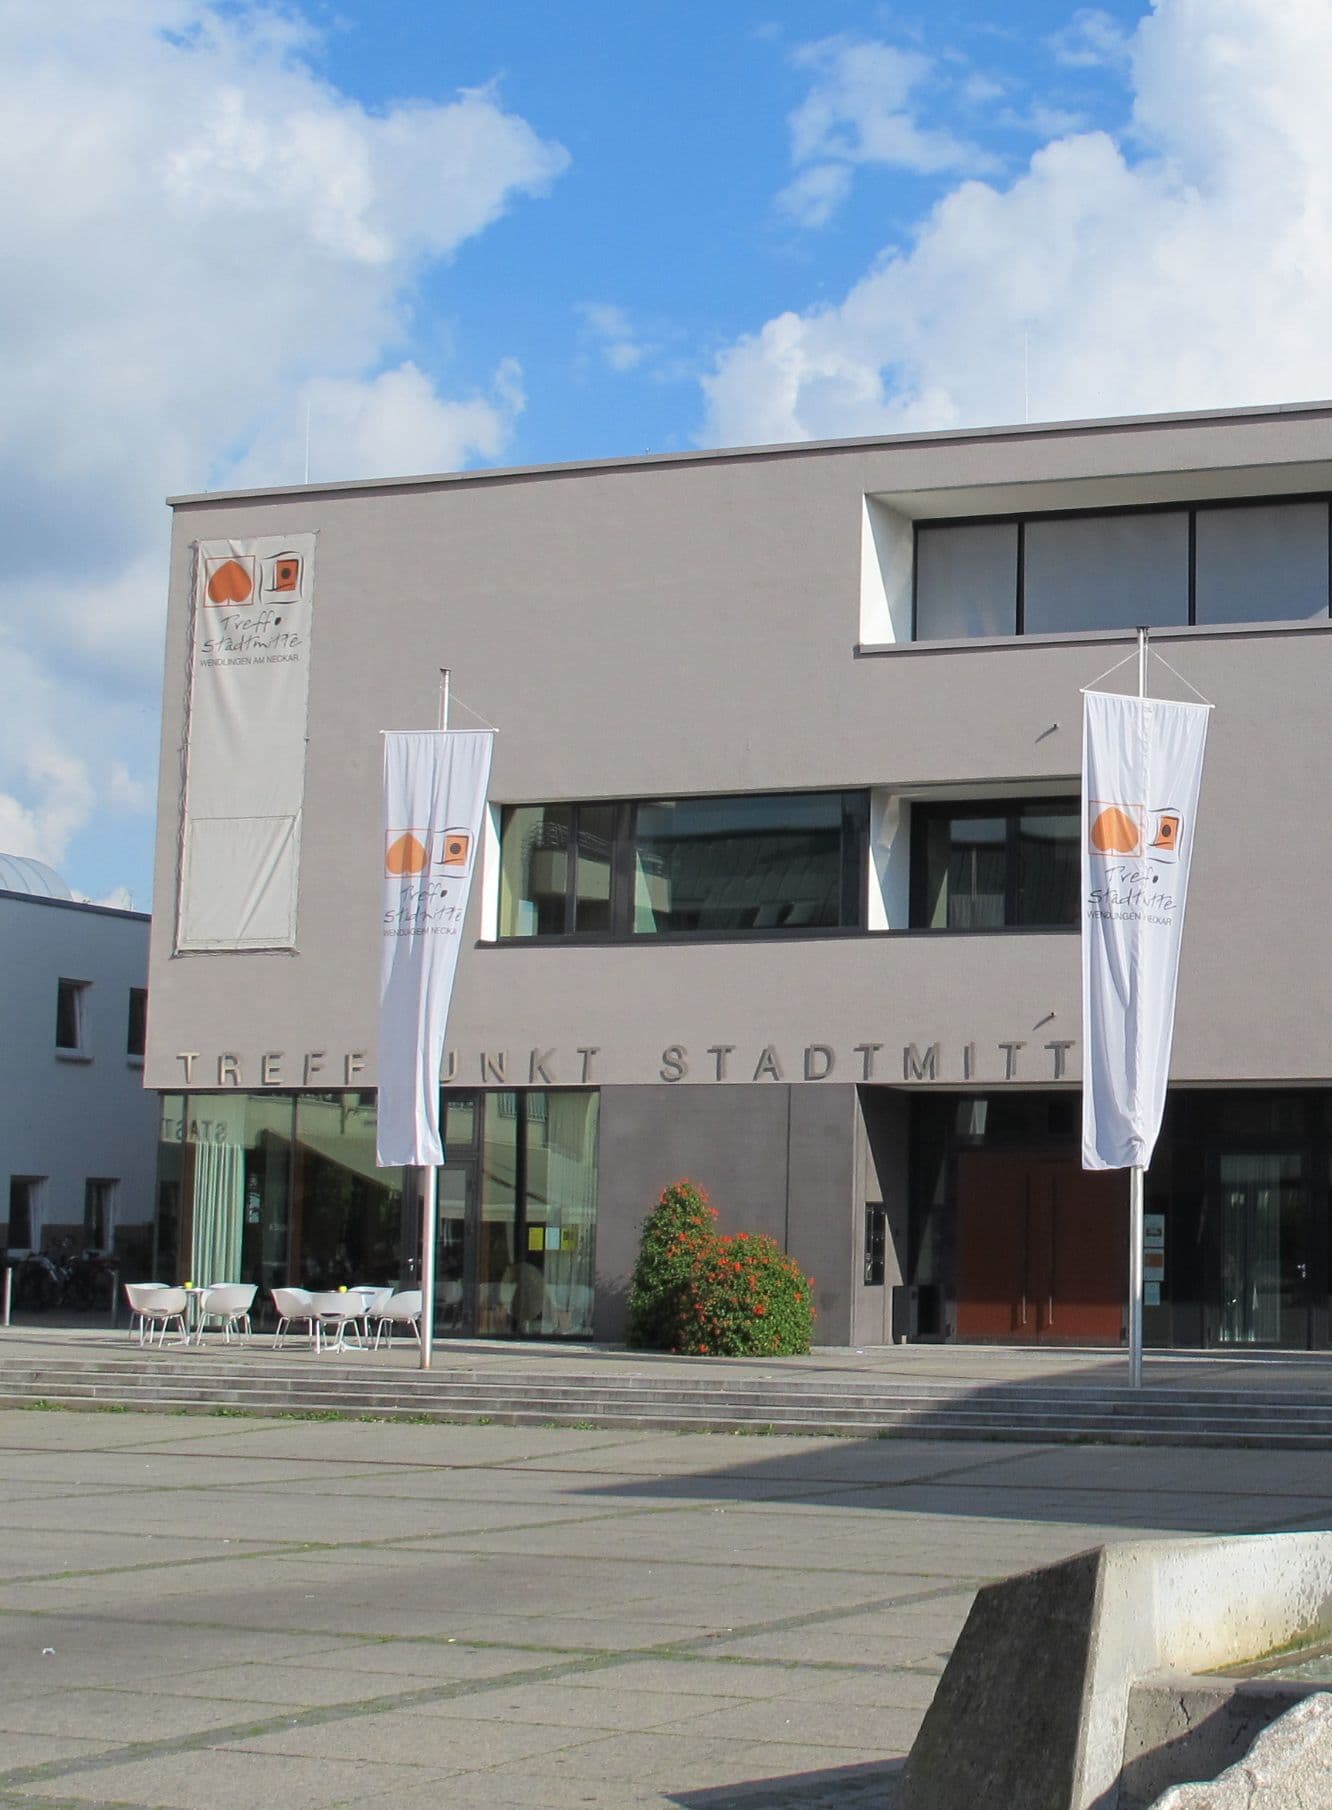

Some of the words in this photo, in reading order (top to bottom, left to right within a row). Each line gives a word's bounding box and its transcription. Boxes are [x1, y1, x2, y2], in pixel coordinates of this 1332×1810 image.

[200, 657, 251, 668] WENDLINGEN
[252, 656, 265, 665] AM
[266, 654, 299, 664] NECKAR
[176, 1047, 600, 1087] TREFFUNKT
[659, 1040, 1077, 1083] STADTMITT
